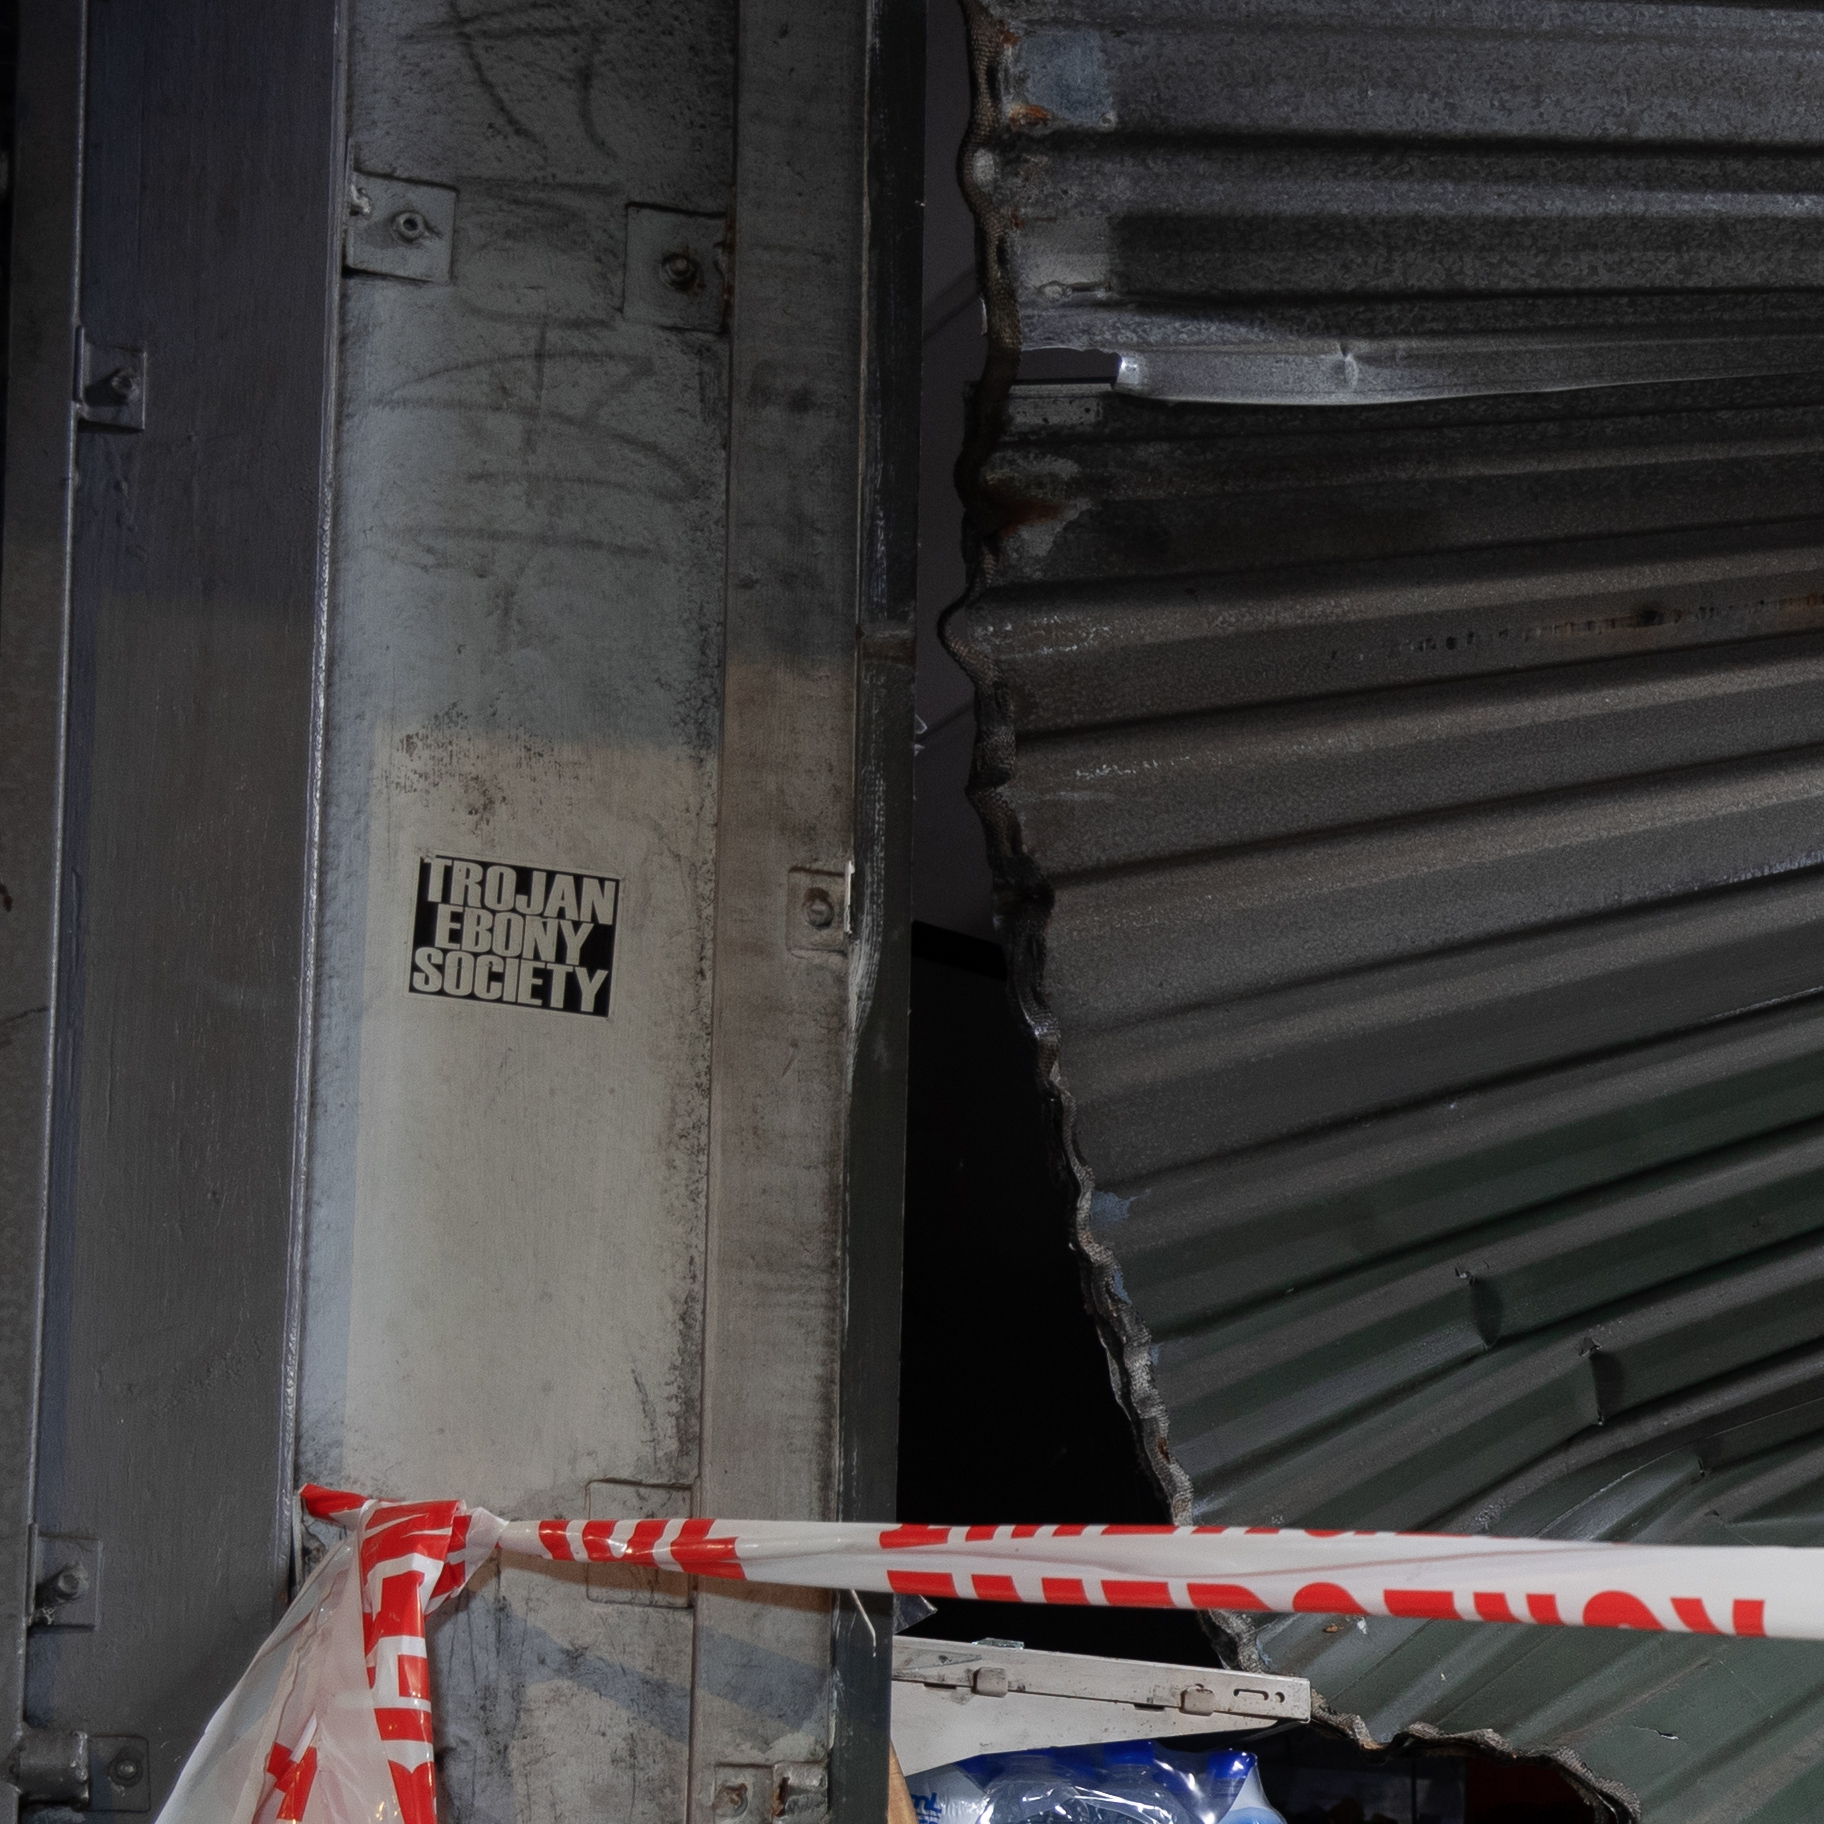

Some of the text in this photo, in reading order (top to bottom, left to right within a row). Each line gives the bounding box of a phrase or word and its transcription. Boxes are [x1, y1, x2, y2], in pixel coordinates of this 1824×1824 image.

[423, 857, 617, 926] TROJAN
[434, 903, 595, 966] EBONY
[412, 946, 610, 1013] SOCIETY
